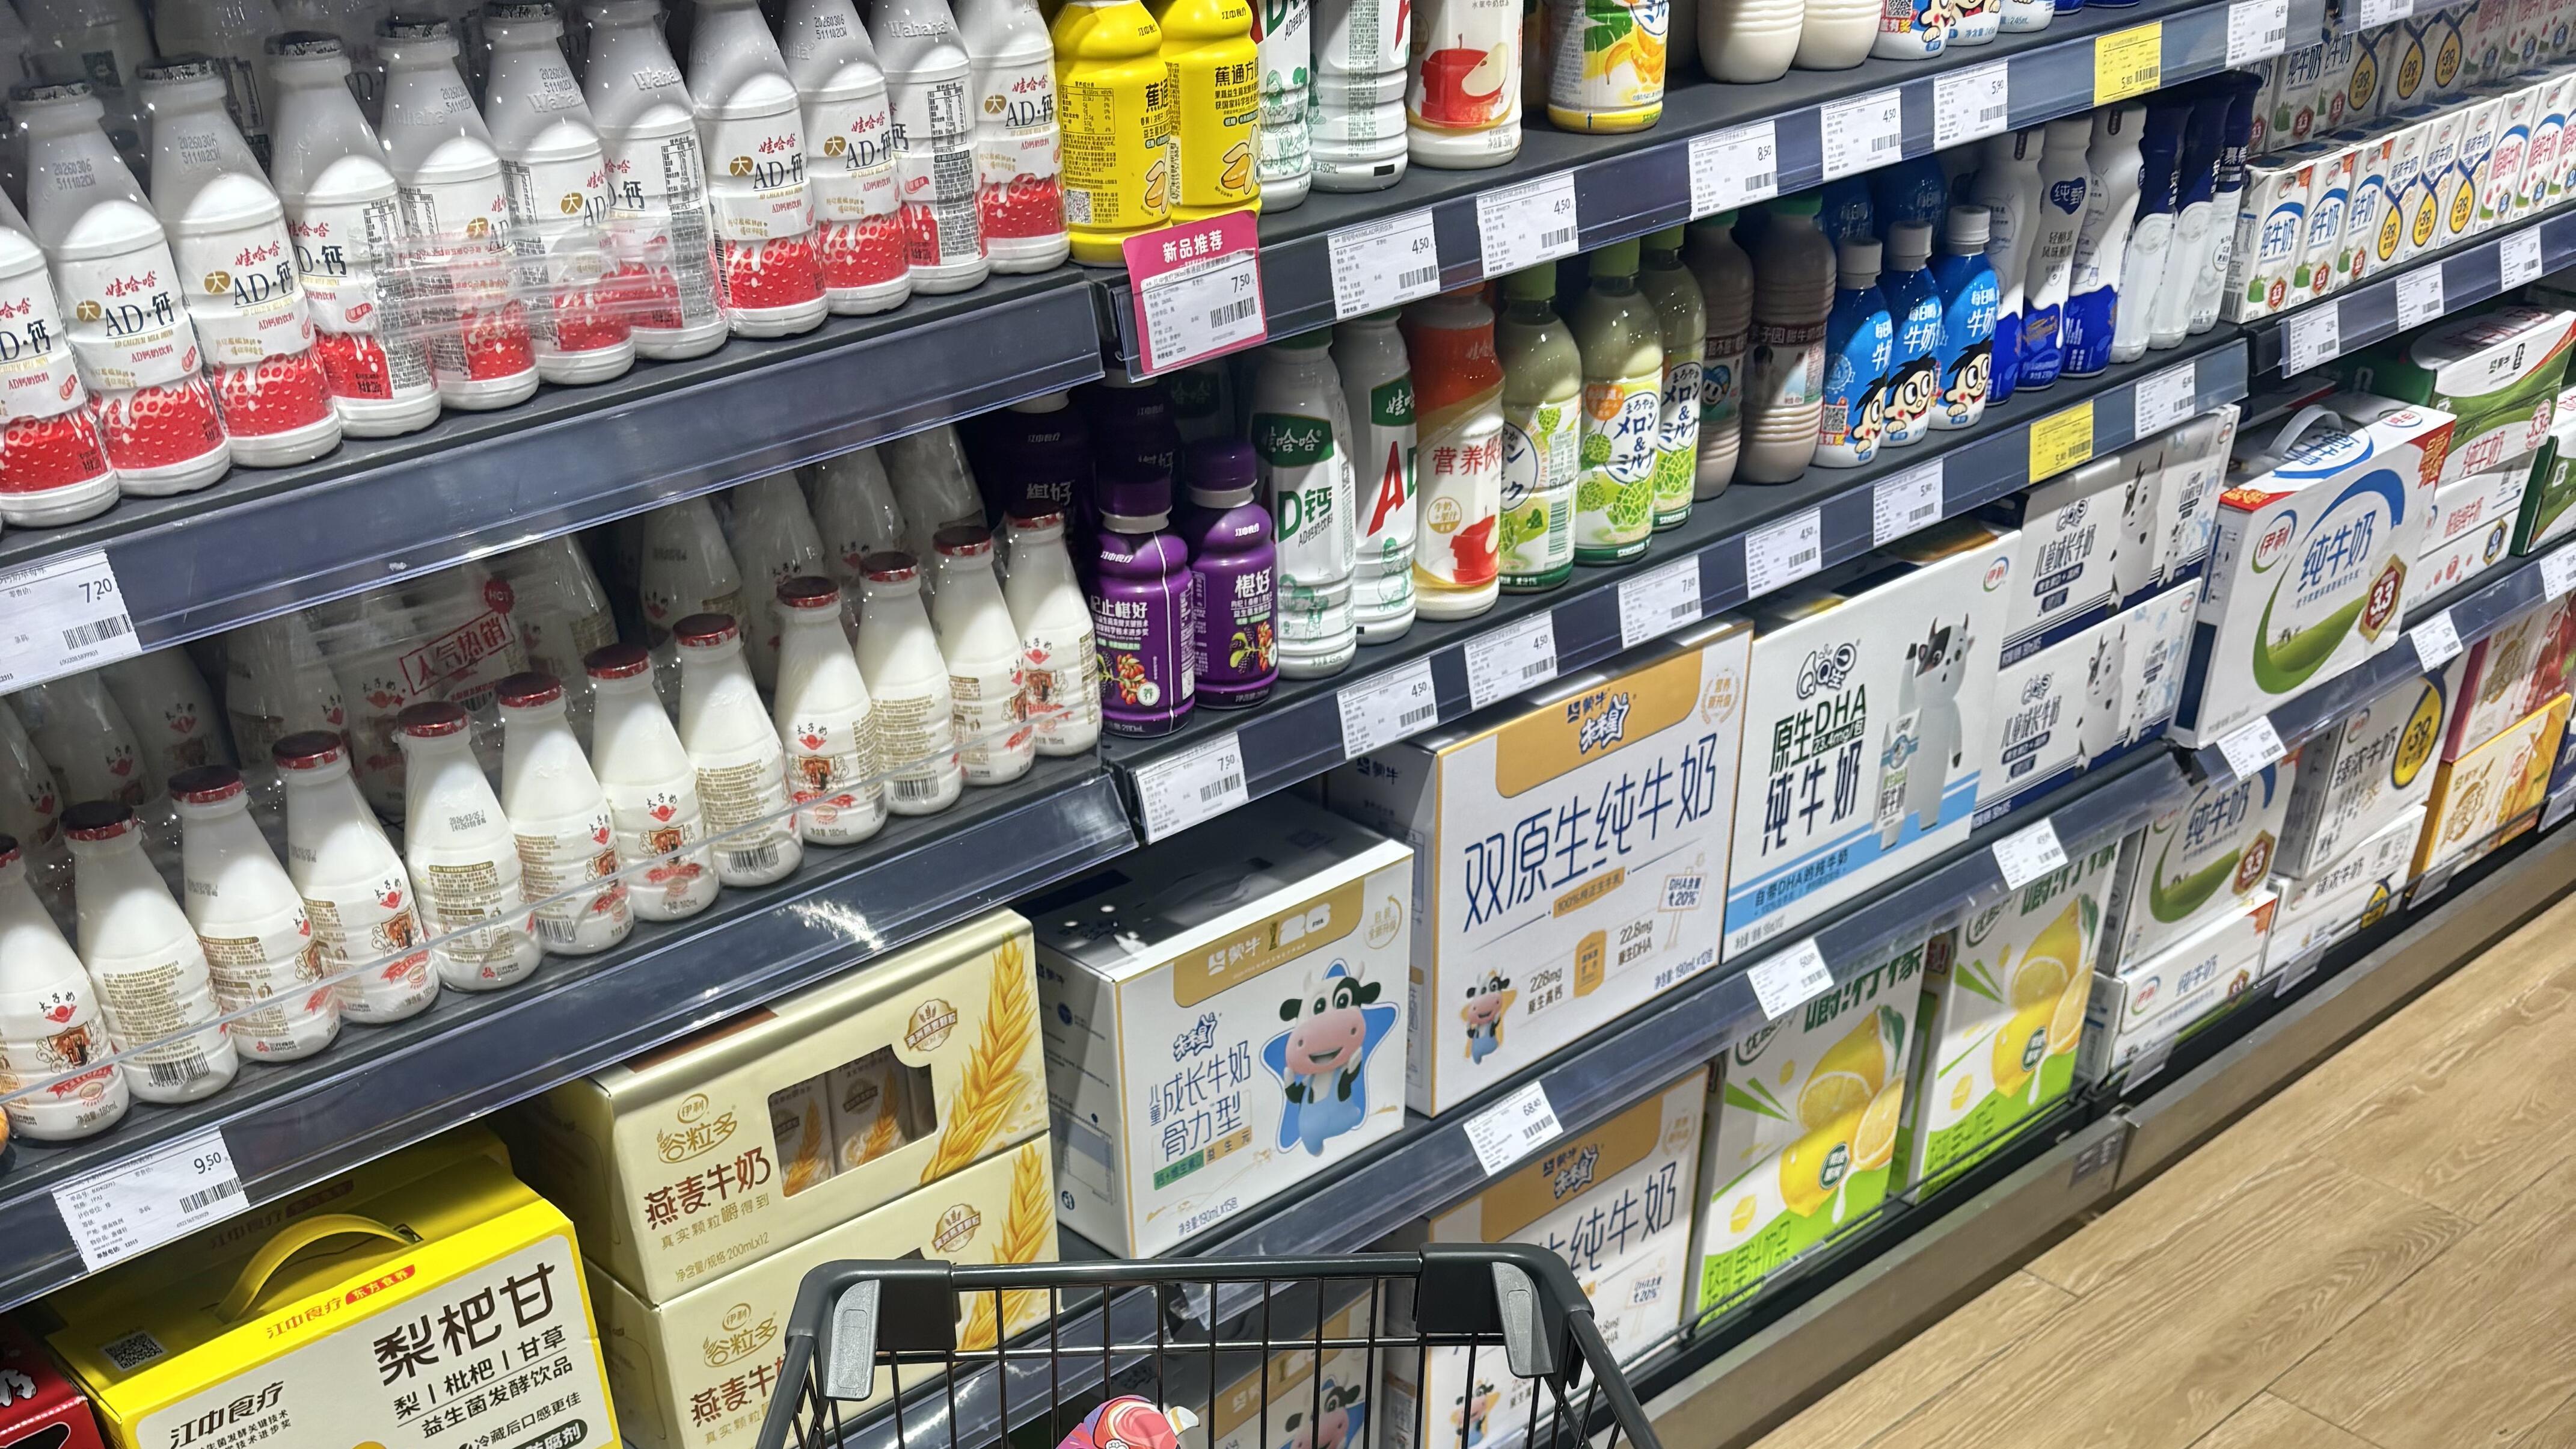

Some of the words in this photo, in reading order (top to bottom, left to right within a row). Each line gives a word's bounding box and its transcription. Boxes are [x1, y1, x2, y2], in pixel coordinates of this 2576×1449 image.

[1012, 75, 1048, 94] 娃哈哈
[851, 111, 885, 134] 娃哈哈
[759, 133, 796, 154] 娃哈哈
[1758, 144, 1771, 161] 8.50
[1554, 197, 1571, 216] 4.50
[235, 241, 280, 266] 娃哈哈
[1162, 229, 1224, 262] 新品推荐
[1412, 236, 1429, 255] 4.50
[106, 270, 156, 297] 娃哈哈
[1231, 272, 1250, 294] 7.50
[2298, 509, 2378, 593] 纯牛奶
[78, 578, 113, 604] 7.20
[488, 589, 510, 601] HOT
[1533, 635, 1548, 651] 4.50
[1411, 681, 1427, 697] 4.50
[1769, 683, 1867, 777] 原生DHA
[1217, 754, 1236, 772] 7.50
[1761, 738, 1863, 858] 纯牛奶
[1462, 733, 1718, 932] 双原生纯牛奶
[1162, 1040, 1251, 1122] 成长牛奶
[681, 1098, 707, 1120] 伊利
[660, 1110, 738, 1158] 谷粒多
[1161, 1090, 1242, 1162] 骨力型
[194, 1152, 222, 1175] 9.50
[644, 1146, 771, 1231] 燕麦牛奶
[660, 1194, 770, 1251] 真实颗粒嚼得到
[352, 1270, 408, 1300] 东方食养
[266, 1297, 342, 1340] 江中食疗
[373, 1261, 555, 1387] 梨杷甘
[705, 1317, 777, 1362] 谷粒多
[394, 1391, 421, 1420] 梨
[444, 1358, 495, 1397] 枇杷
[517, 1325, 567, 1362] 甘草
[422, 1356, 573, 1439] 益生菌发酵饮品
[171, 1380, 284, 1449] 江中食疗
[476, 1392, 581, 1449] 冷藏后口感更佳
